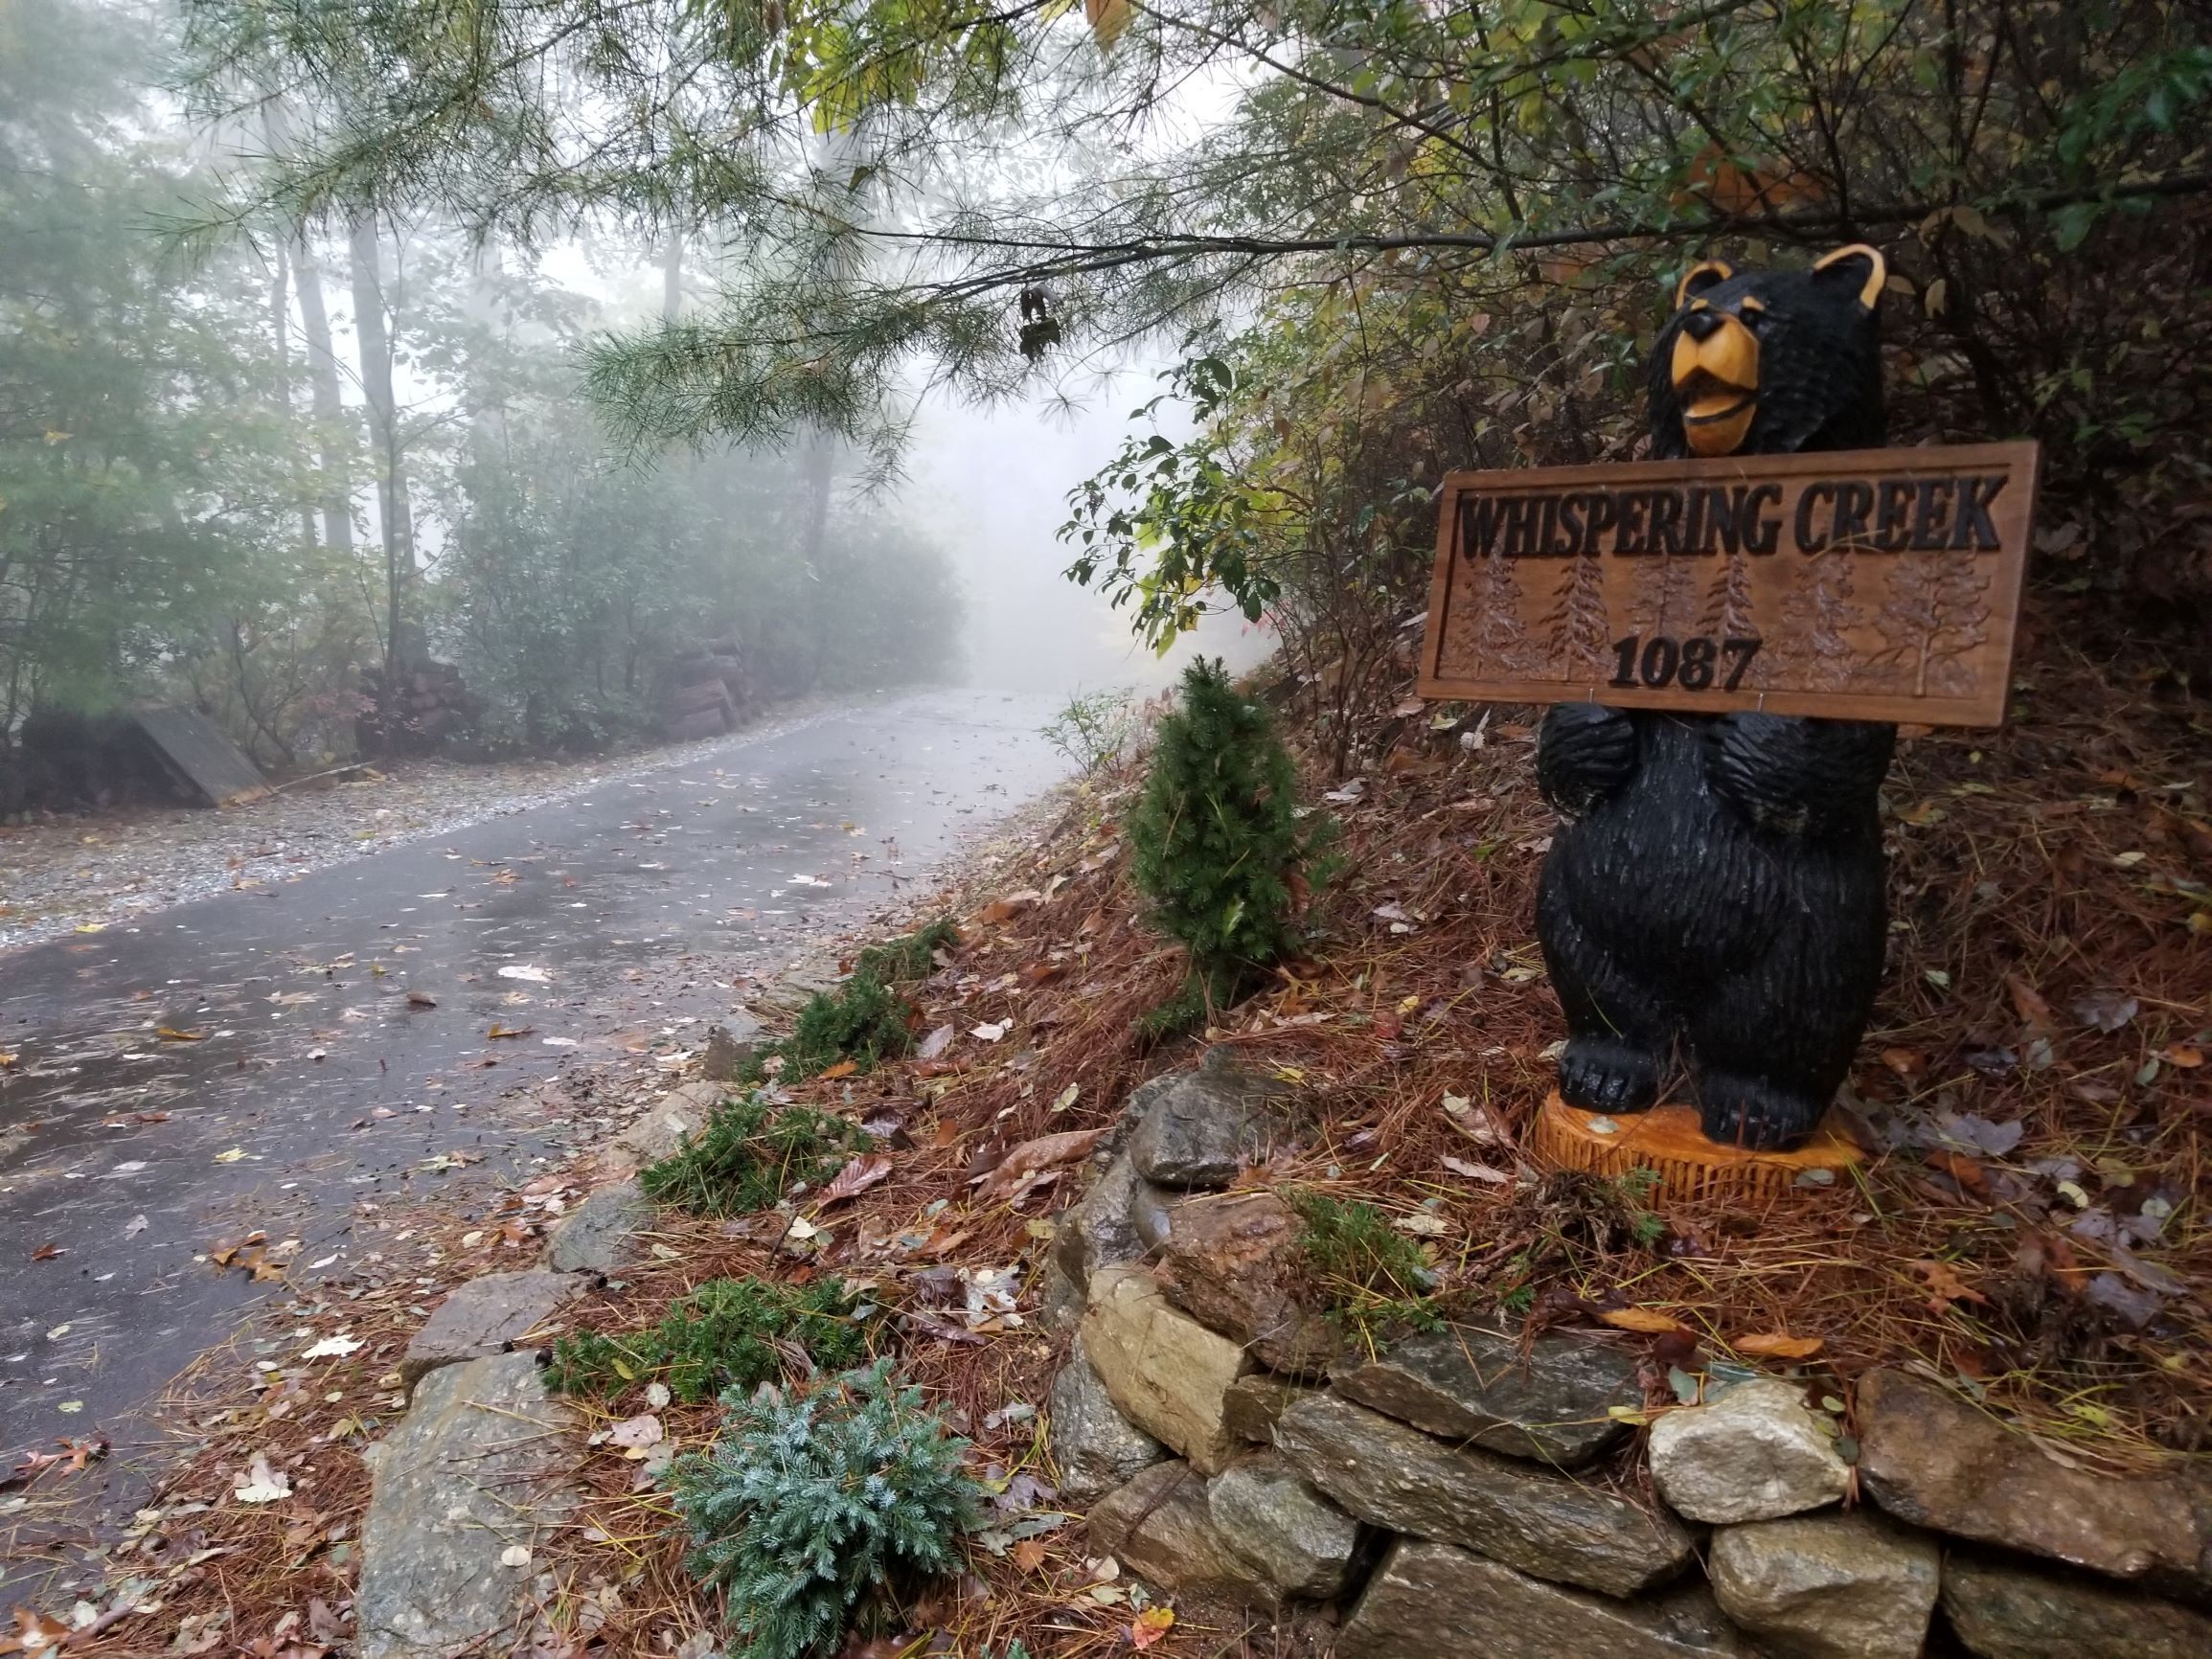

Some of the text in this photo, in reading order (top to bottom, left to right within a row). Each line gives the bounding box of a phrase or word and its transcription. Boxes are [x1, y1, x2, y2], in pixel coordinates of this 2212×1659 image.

[1461, 475, 2009, 559] WHISPERING CREEK
[1608, 635, 1762, 691] 1087
